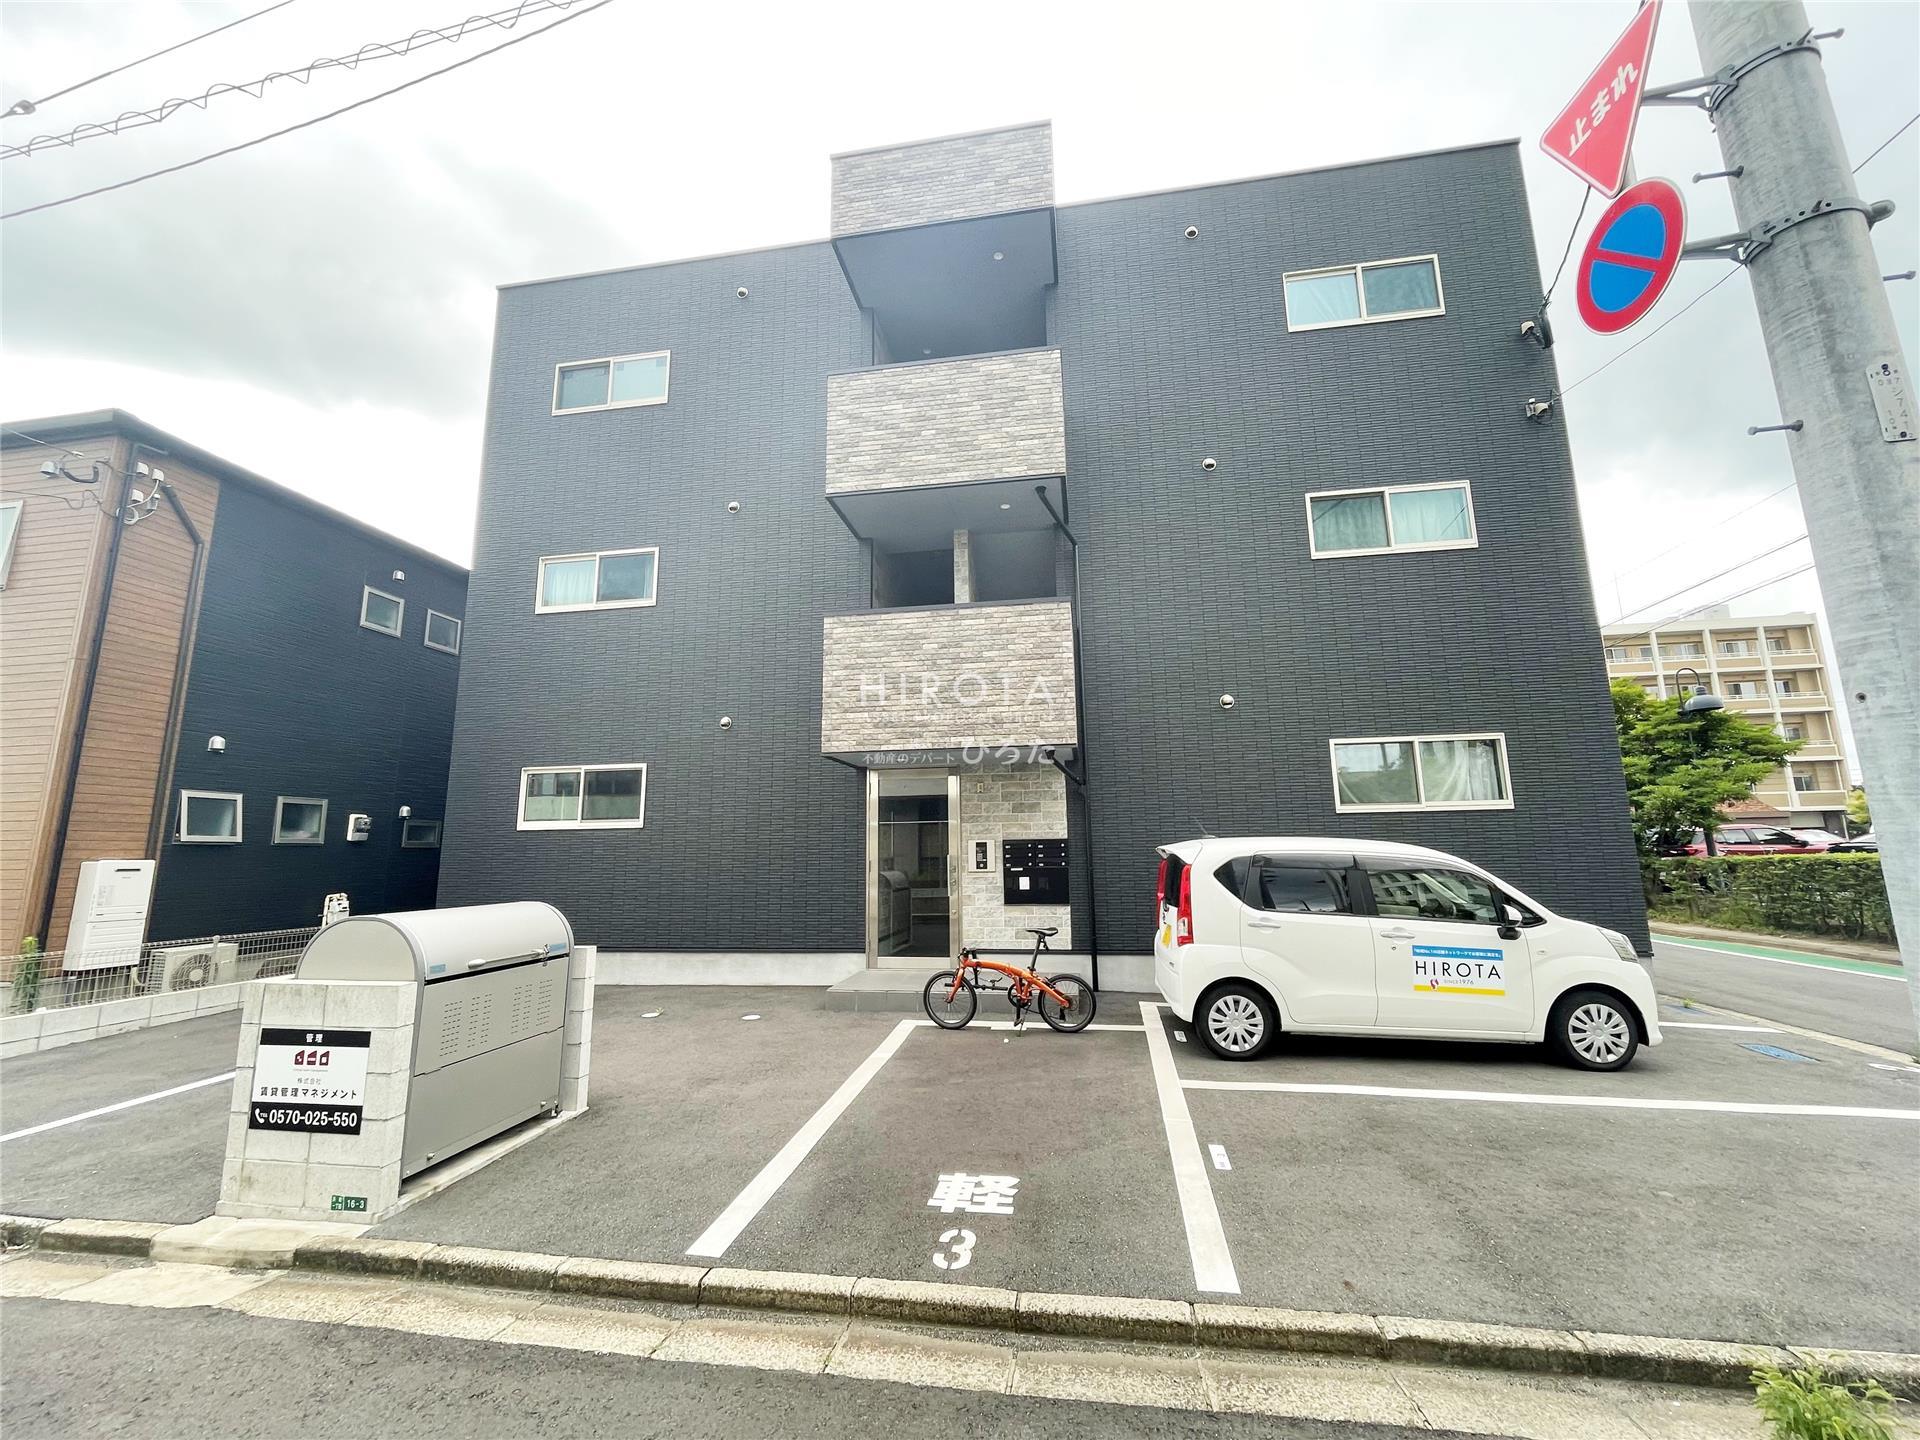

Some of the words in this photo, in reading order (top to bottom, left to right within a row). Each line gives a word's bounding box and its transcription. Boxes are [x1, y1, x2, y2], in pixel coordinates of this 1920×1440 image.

[1569, 62, 1638, 157] 止まれ
[1416, 961, 1501, 979] HIROTA
[306, 1033, 324, 1043] 管理
[297, 1077, 322, 1085] 株式会社
[260, 1086, 358, 1100] 賃貸管理マネジメント
[269, 1109, 358, 1127] 0570-025-550
[927, 1173, 1021, 1214] 軽
[347, 1199, 365, 1209] 16-3
[933, 1229, 977, 1270] 3
